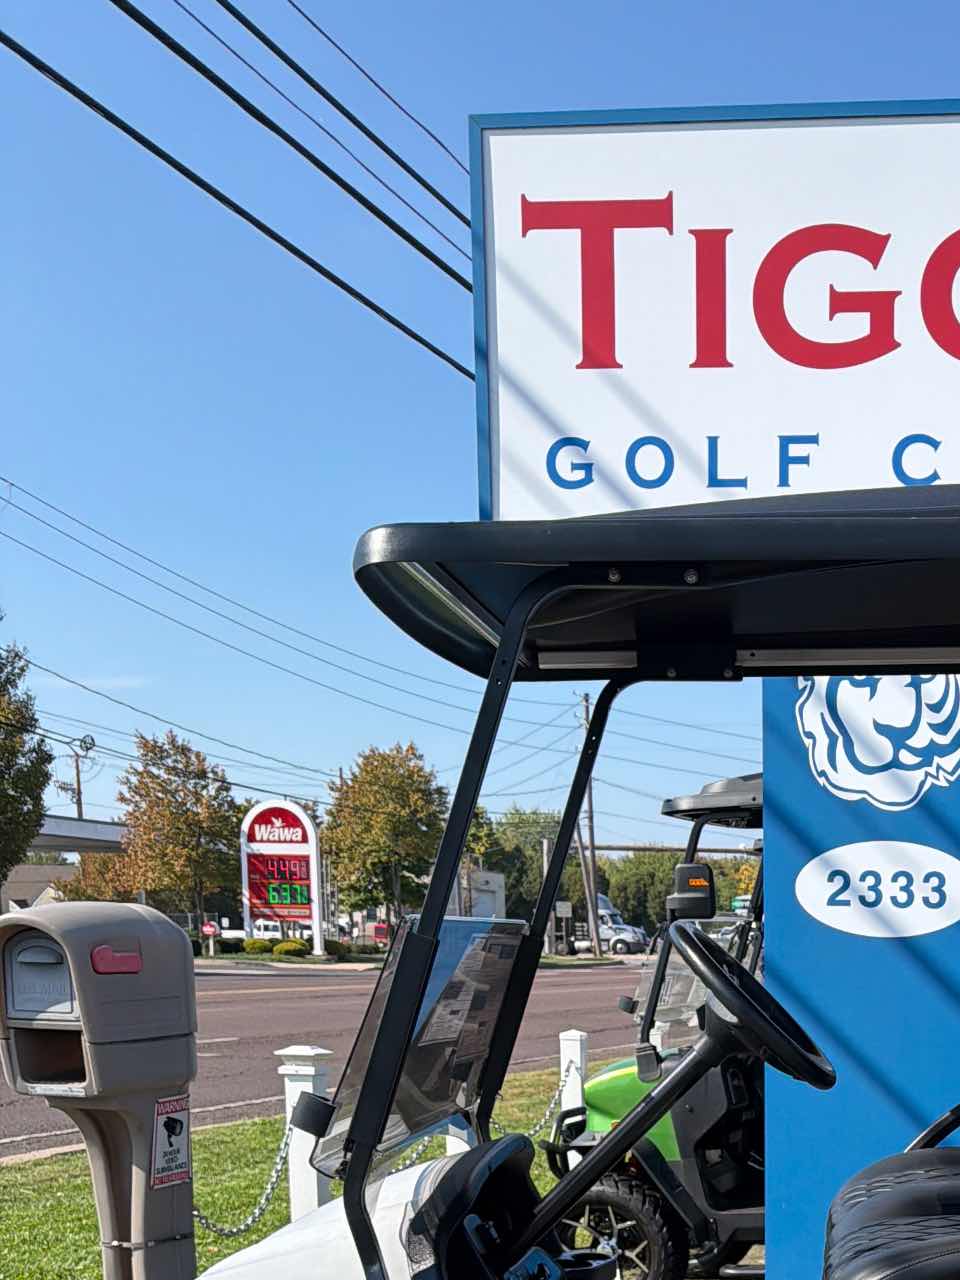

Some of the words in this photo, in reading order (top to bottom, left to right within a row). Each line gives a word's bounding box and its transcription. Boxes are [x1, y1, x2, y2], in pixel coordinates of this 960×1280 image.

[546, 432, 820, 490] GOLF
[254, 823, 303, 842] Wawa
[826, 869, 947, 910] 2333
